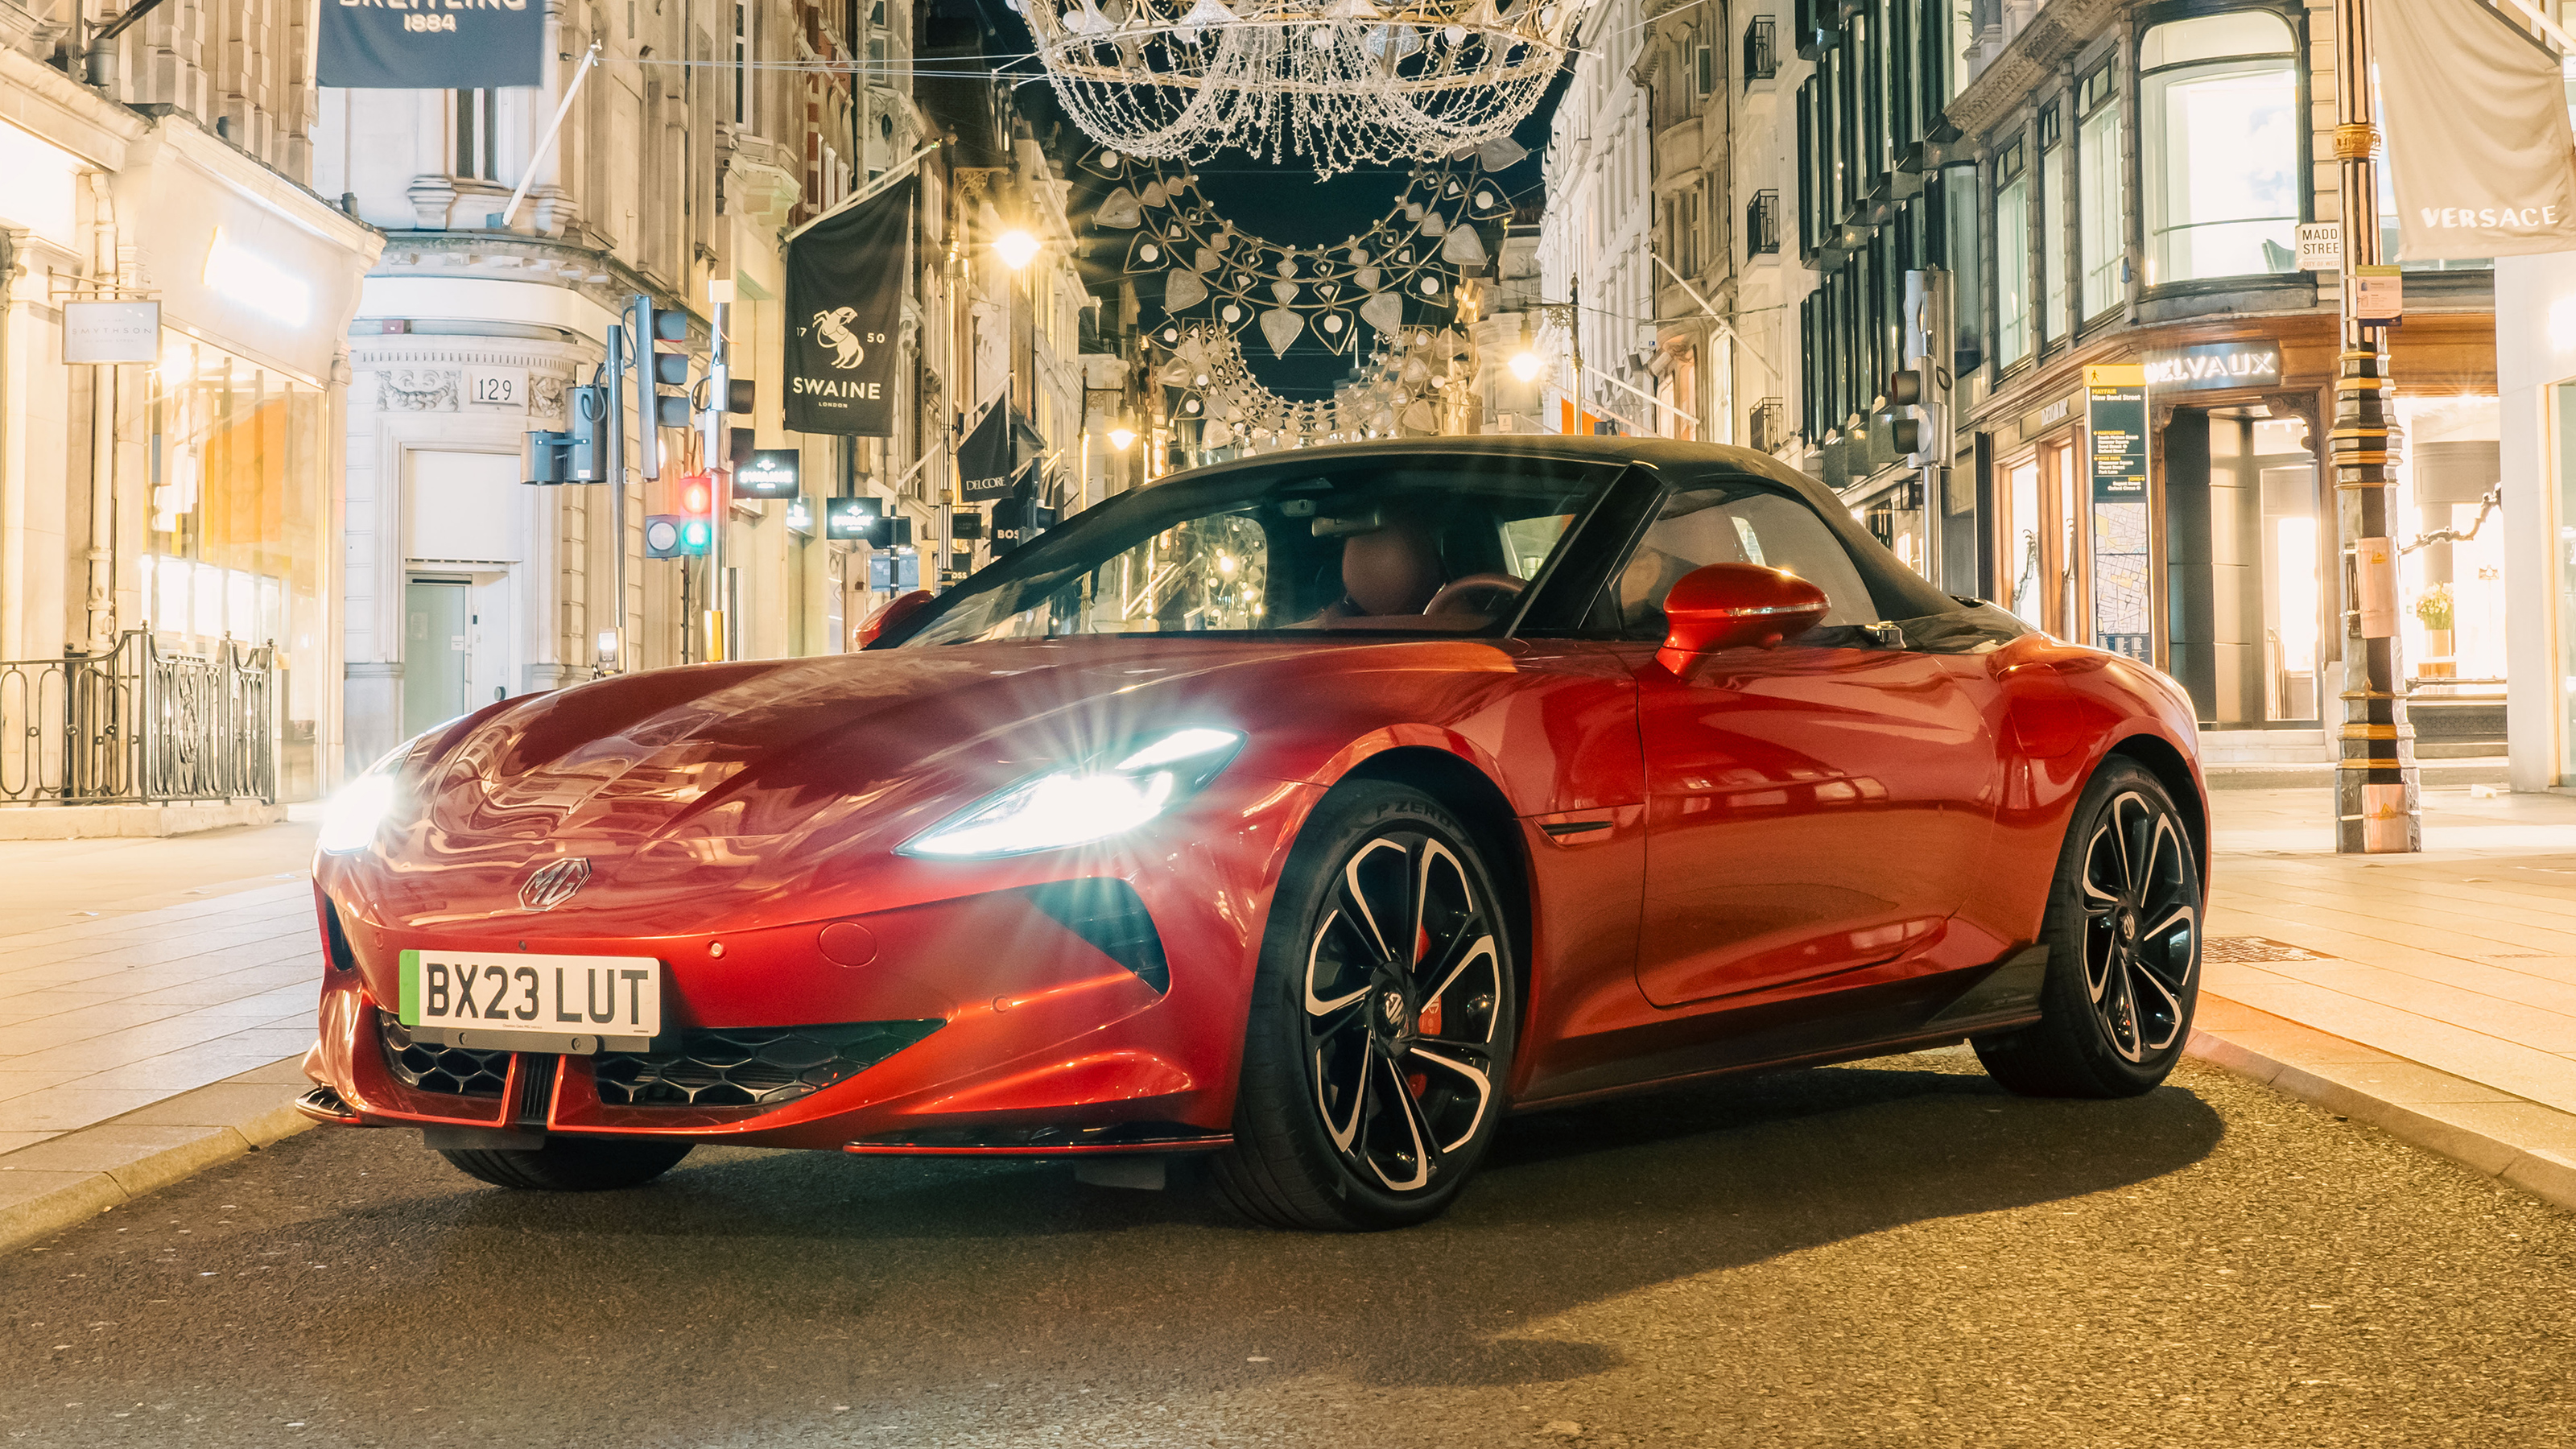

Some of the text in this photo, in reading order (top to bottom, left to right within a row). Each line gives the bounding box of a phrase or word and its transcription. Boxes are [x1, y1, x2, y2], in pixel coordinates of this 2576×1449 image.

[404, 14, 457, 33] 1884
[2420, 205, 2559, 228] VERSACE
[2302, 229, 2338, 241] MADD
[2303, 242, 2339, 254] STREE
[72, 327, 152, 335] SMYTHSON
[796, 327, 886, 343] 17 50
[2144, 352, 2276, 383] DELVAUX
[479, 378, 512, 401] 129
[792, 377, 881, 399] SWAINE
[966, 476, 1006, 490] DELCORE
[997, 530, 1019, 539] BOS
[1395, 801, 1452, 828] ZERO
[523, 860, 585, 906] MG
[427, 963, 649, 1026] BX23 LUT
